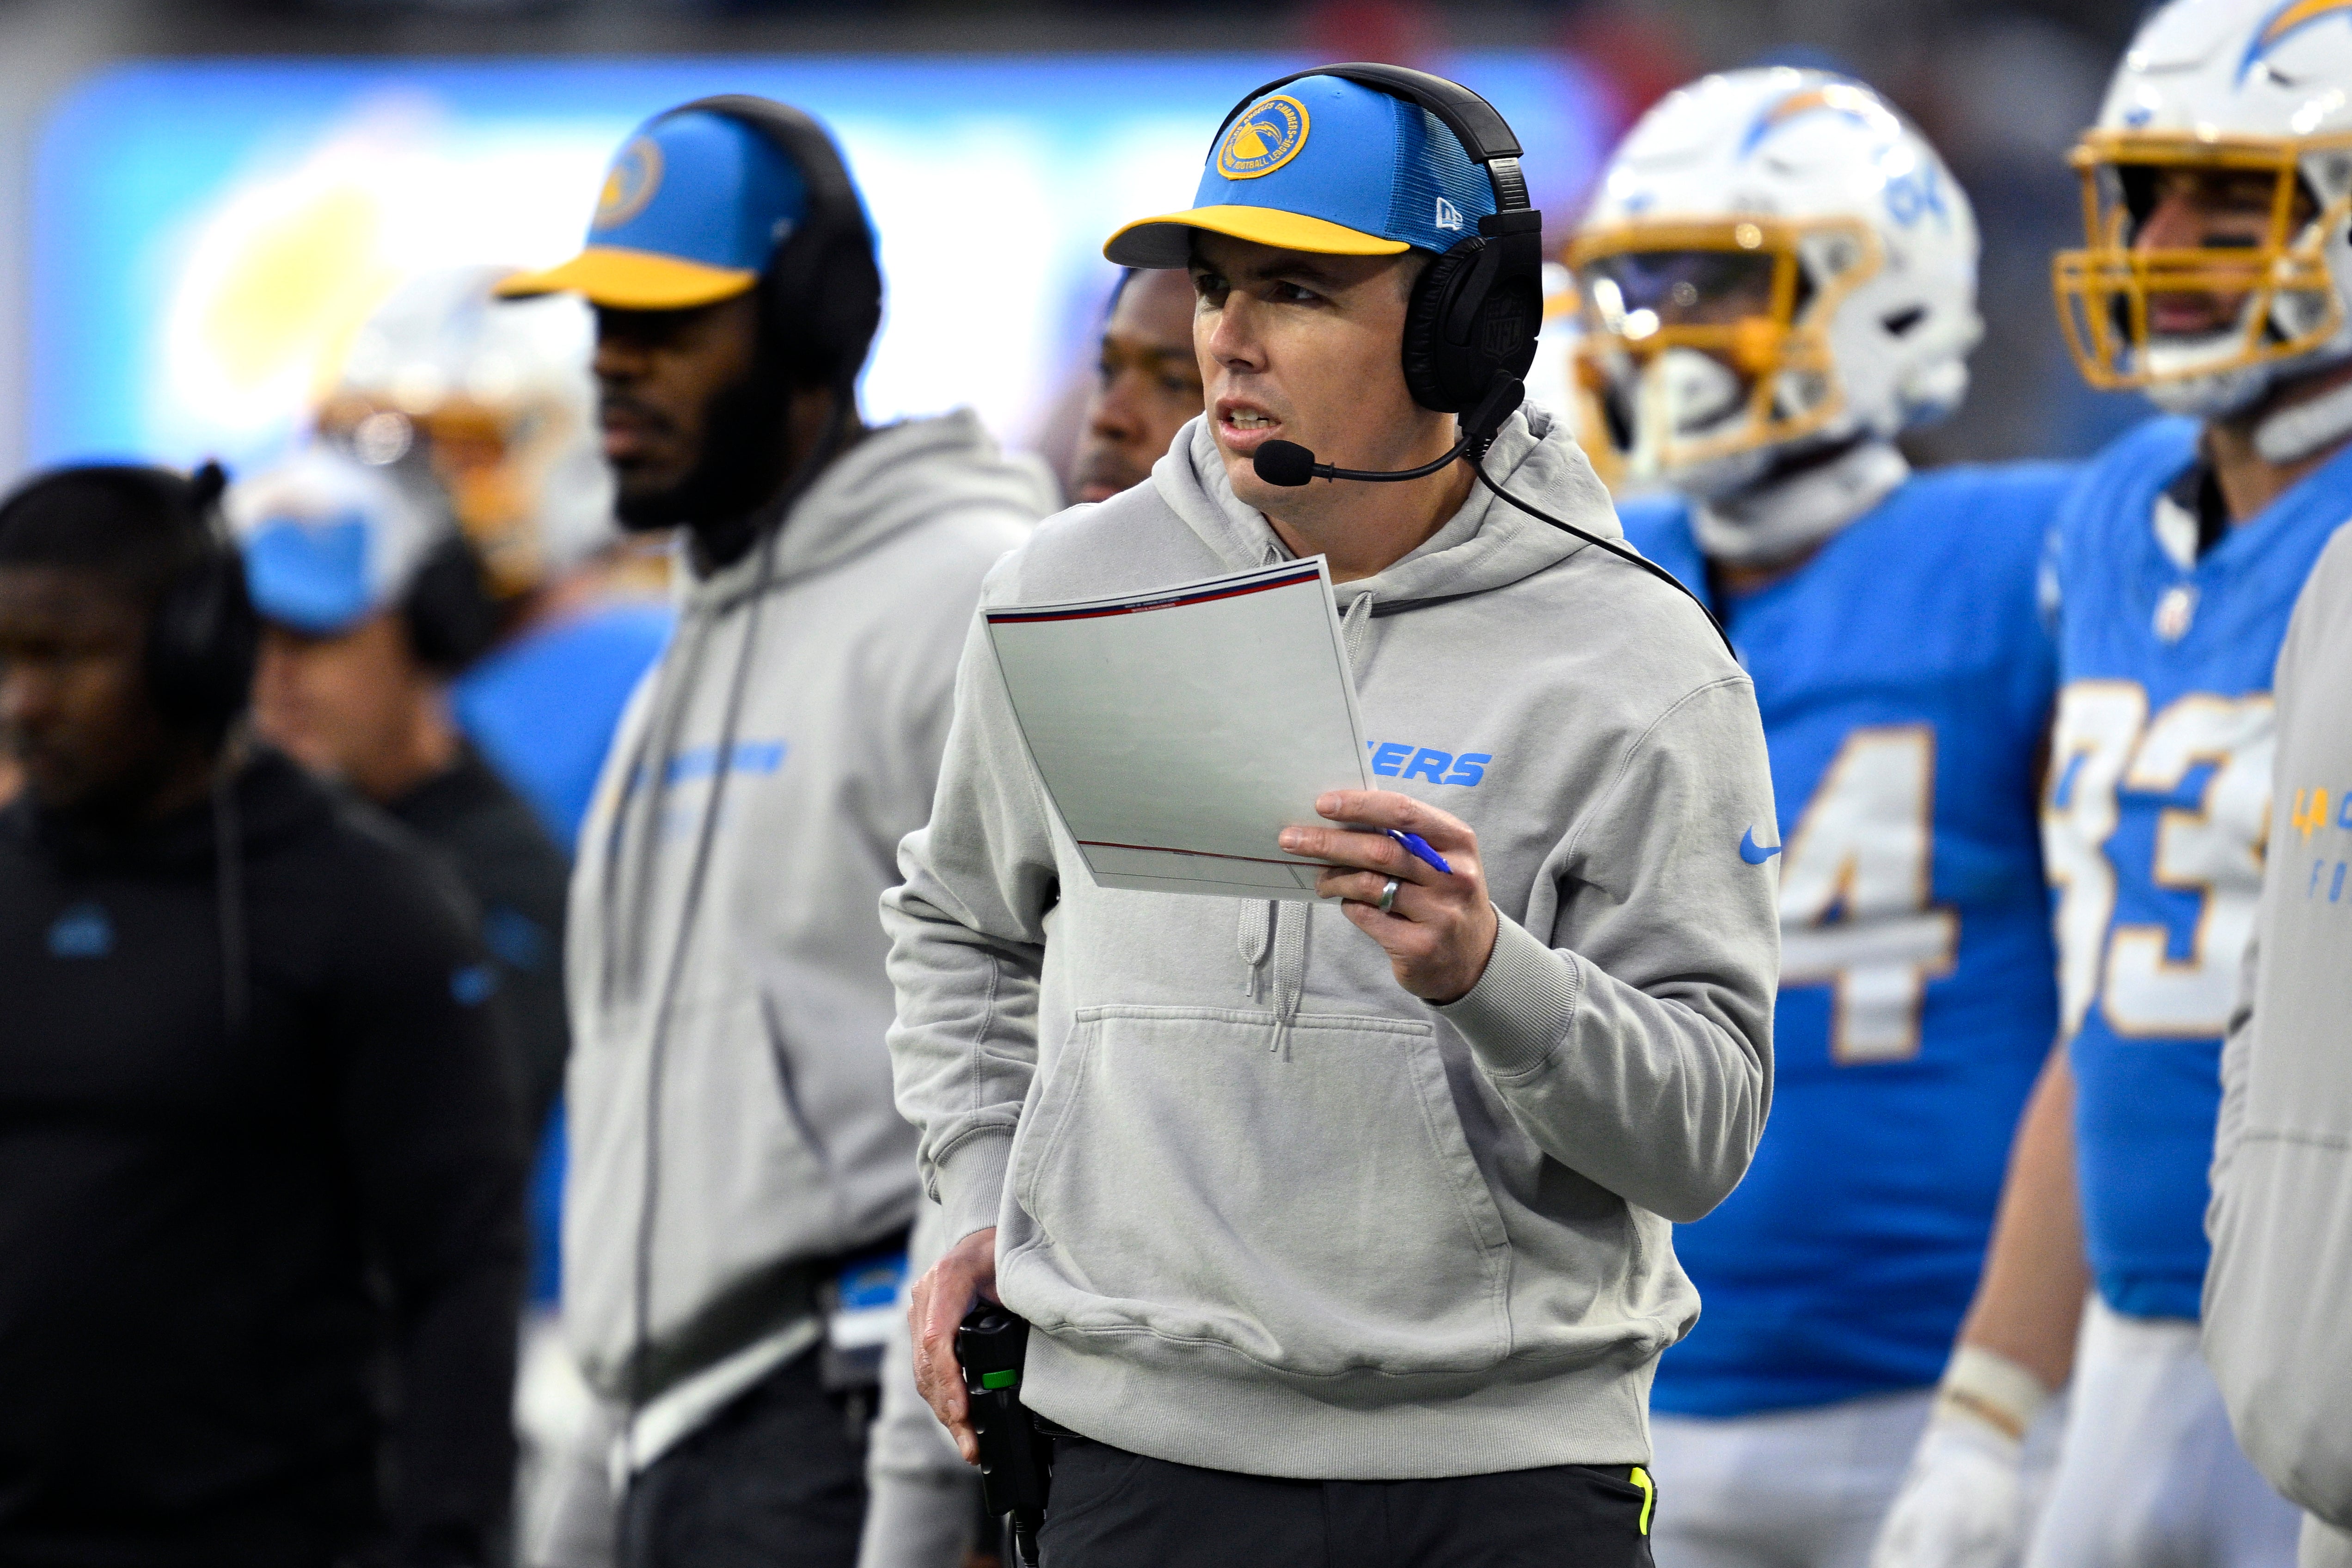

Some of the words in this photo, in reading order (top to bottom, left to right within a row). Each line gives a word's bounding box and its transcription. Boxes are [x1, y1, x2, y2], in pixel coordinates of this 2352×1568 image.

[1275, 103, 1298, 135] CHARGERS
[1269, 138, 1293, 161] LEAGUE
[1367, 741, 1493, 787] ERS
